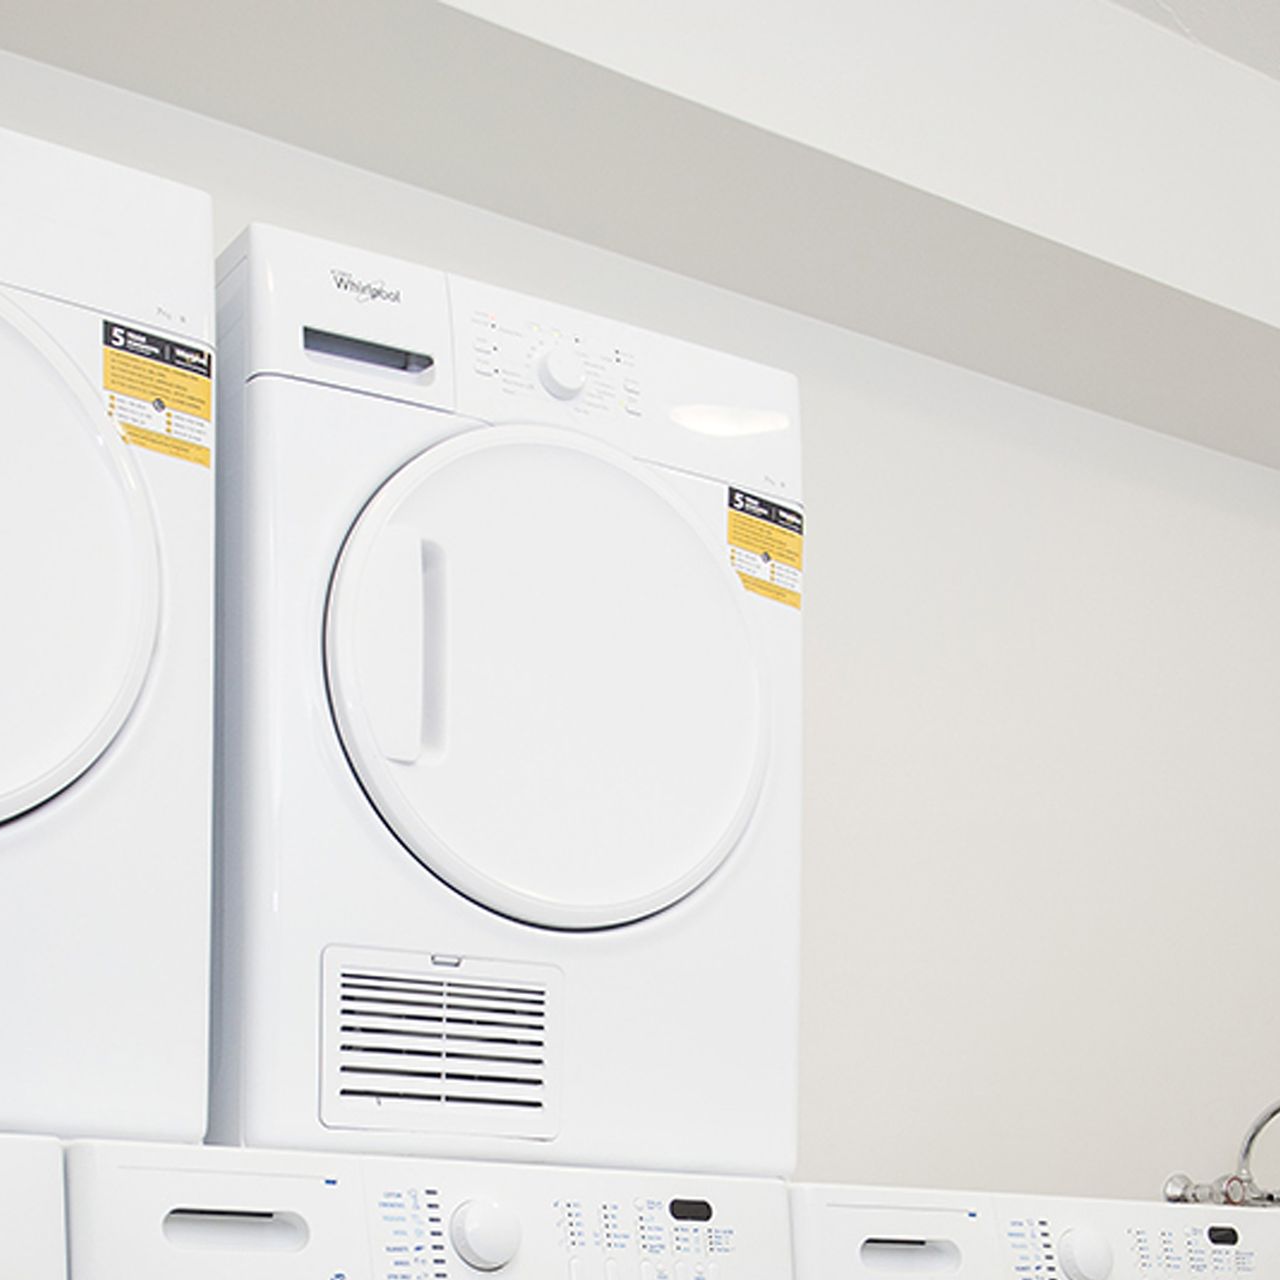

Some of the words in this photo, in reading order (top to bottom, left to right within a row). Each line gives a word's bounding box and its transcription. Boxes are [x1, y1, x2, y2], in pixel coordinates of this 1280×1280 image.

[333, 275, 401, 304] Whirlpool
[111, 326, 125, 346] 5
[734, 493, 745, 509] 5
